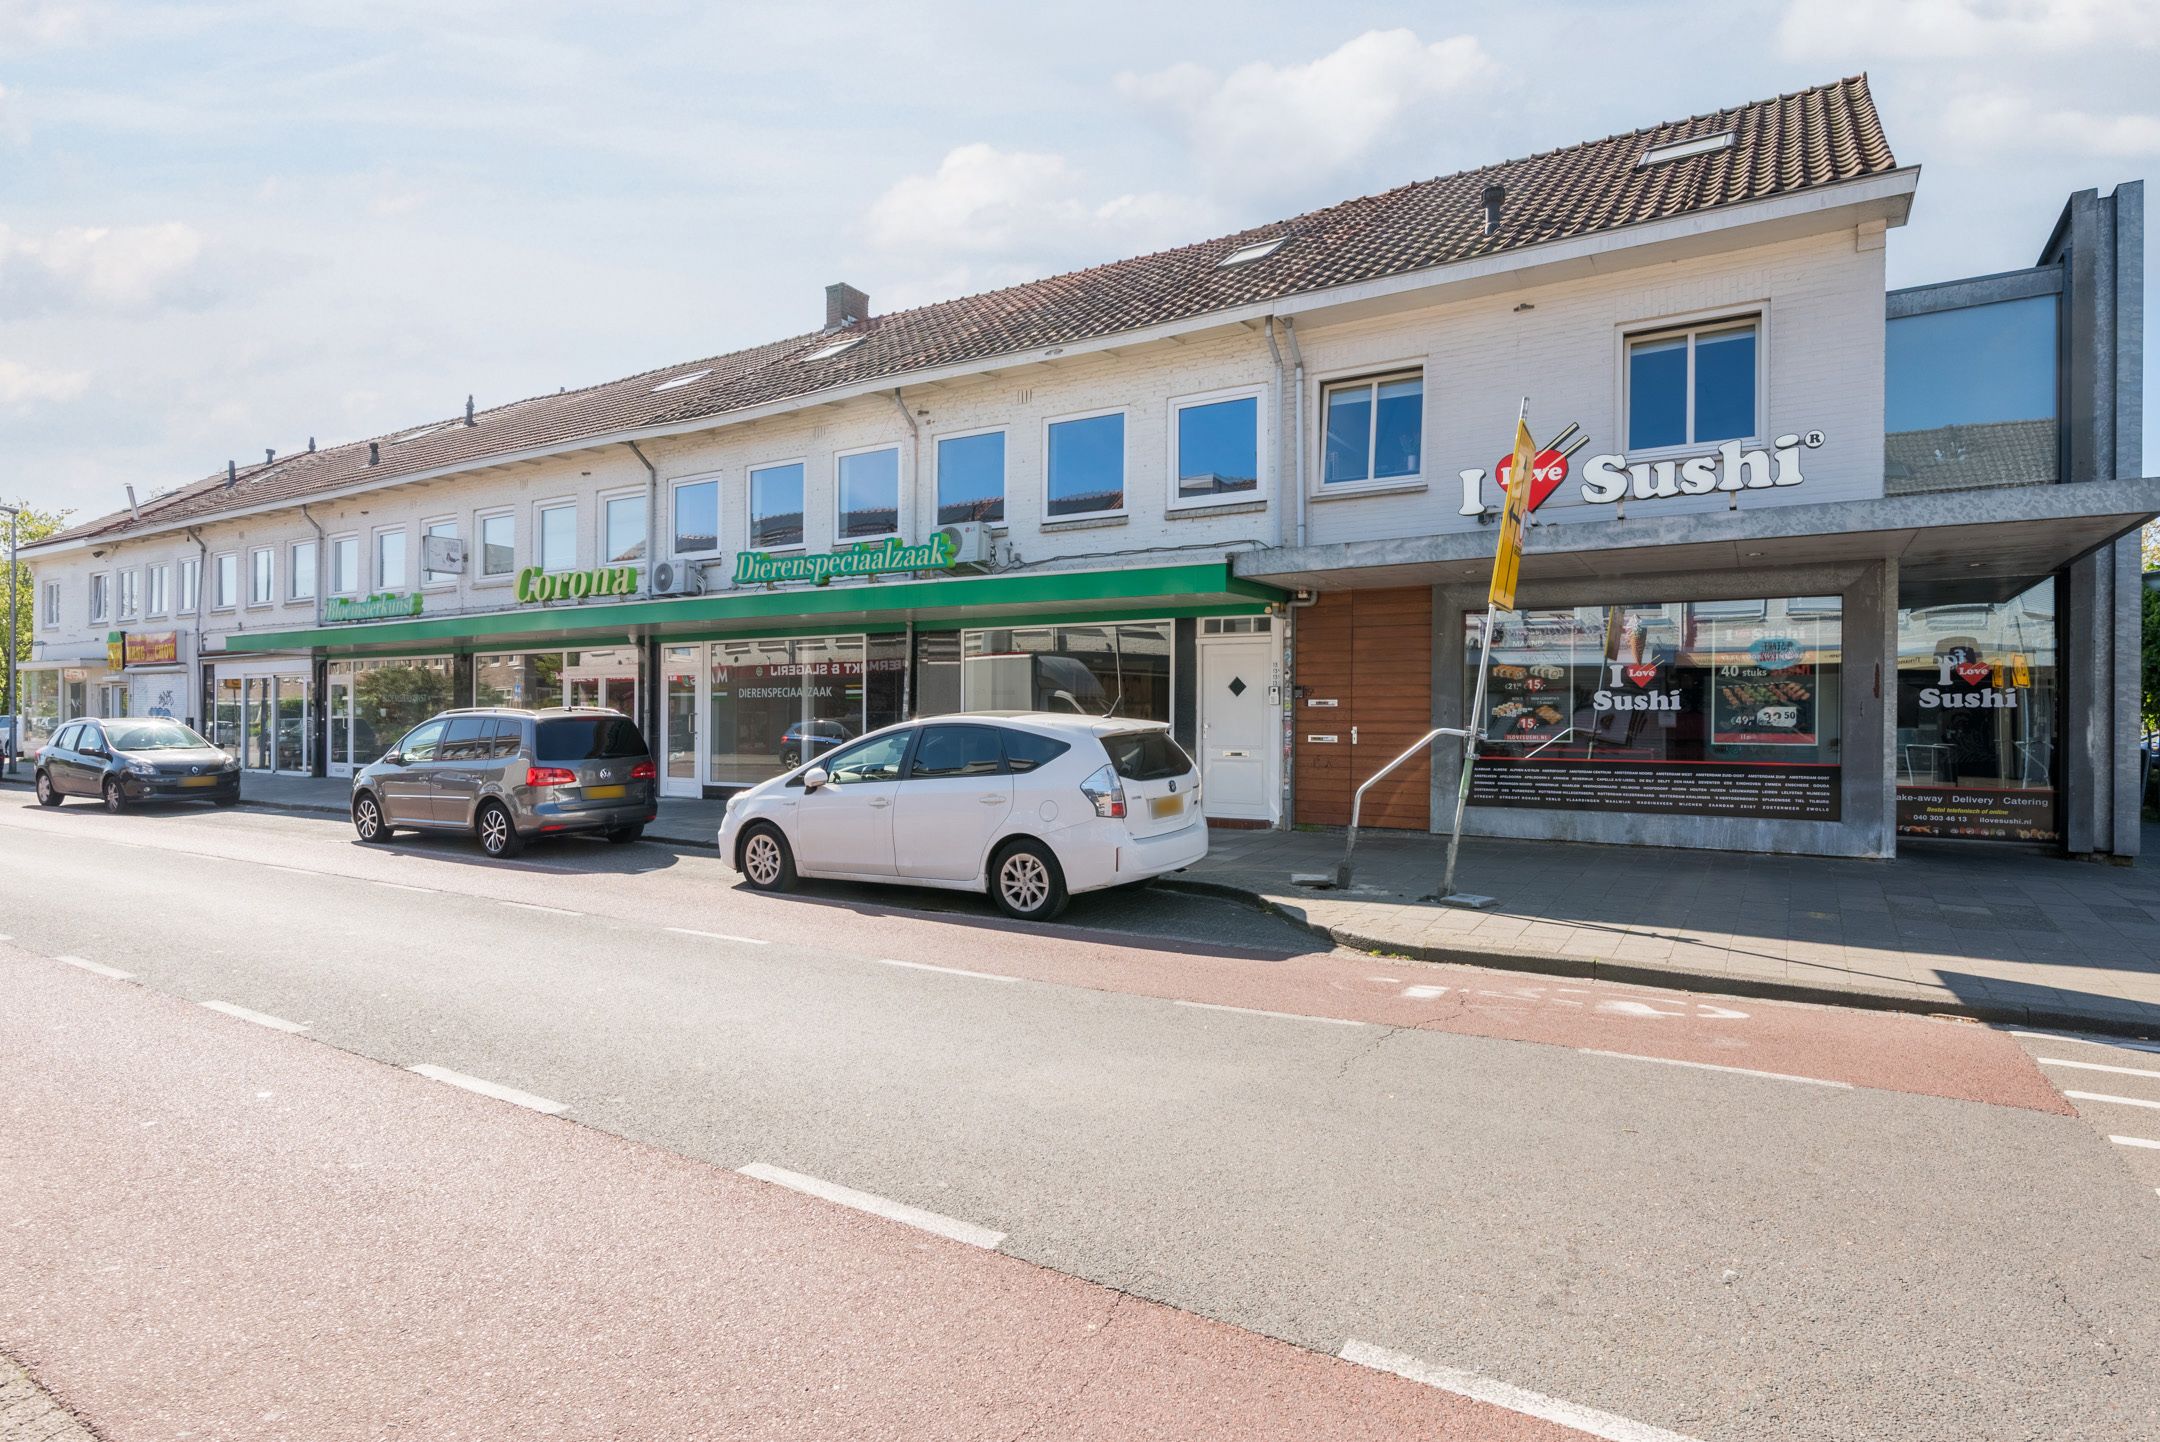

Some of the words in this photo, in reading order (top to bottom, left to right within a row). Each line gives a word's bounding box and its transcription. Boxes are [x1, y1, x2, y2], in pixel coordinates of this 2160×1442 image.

[1458, 468, 1487, 516] I
[1500, 465, 1563, 485] Lve
[1580, 434, 1804, 504] Sushi
[734, 535, 948, 583] Dierenspeciaalzaak
[513, 565, 634, 603] Corona
[1609, 664, 1624, 688] I
[1629, 668, 1656, 677] Love
[1721, 665, 1739, 676] 40
[1742, 668, 1767, 676] stuks
[1959, 666, 1989, 675] Love
[738, 686, 832, 698] DIERENSPECIAAZAAK
[1593, 689, 1682, 710] Sushi
[1919, 687, 2018, 708] Sushi
[1896, 794, 1943, 804] ake-away
[1952, 795, 1994, 805] Delivery
[2003, 796, 2049, 808] Catering
[1979, 816, 2032, 825] ilovesushi.nl
